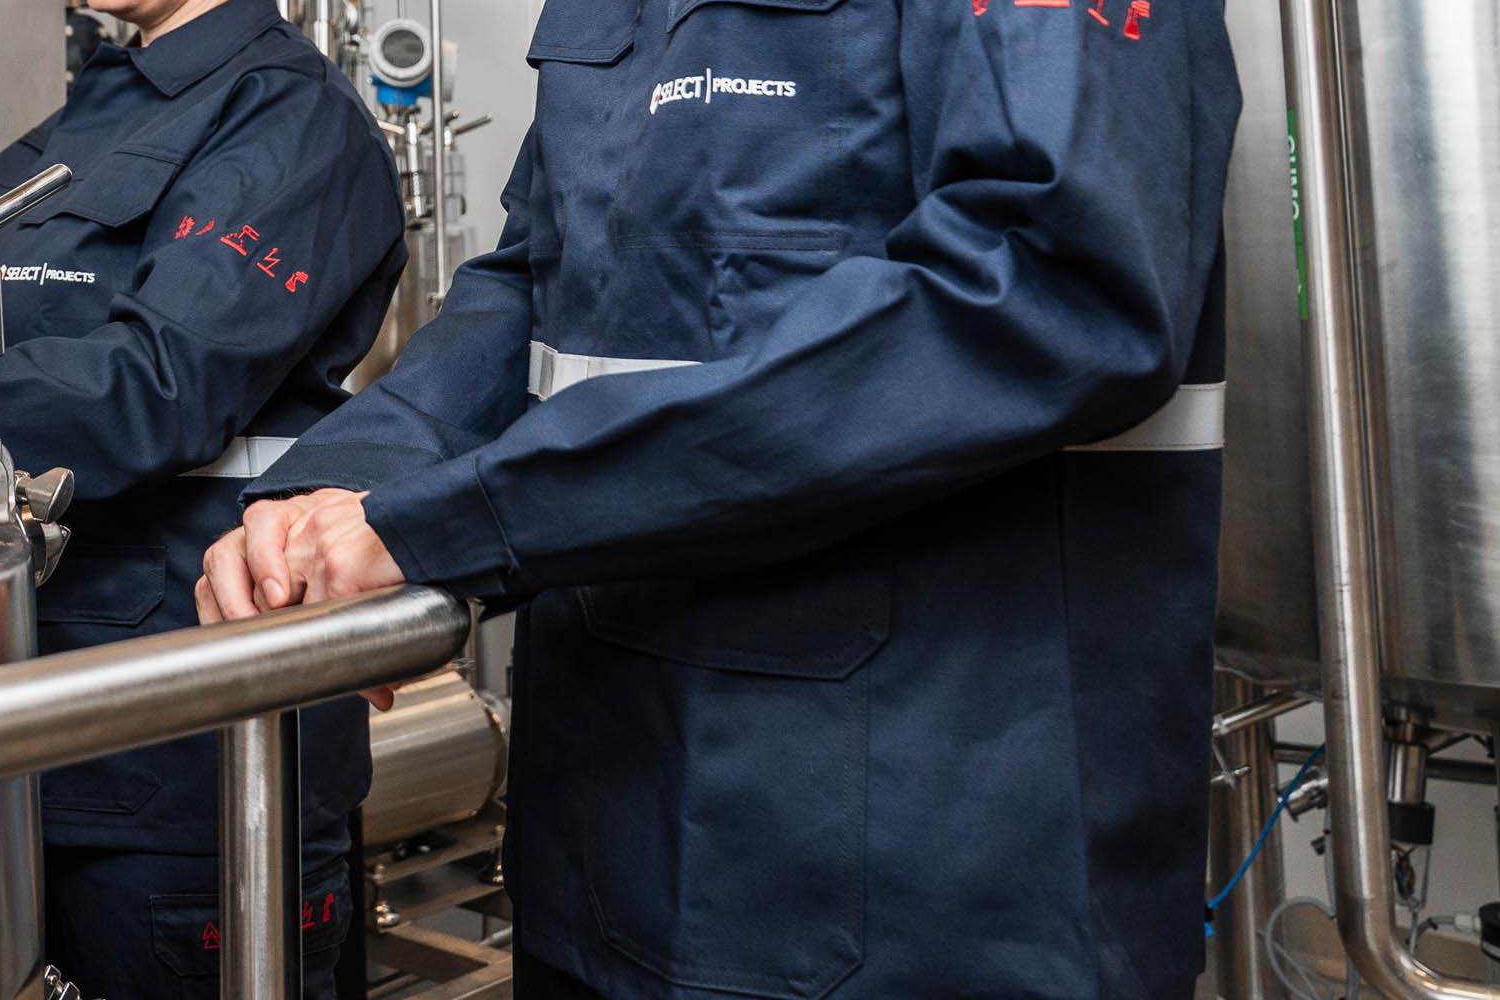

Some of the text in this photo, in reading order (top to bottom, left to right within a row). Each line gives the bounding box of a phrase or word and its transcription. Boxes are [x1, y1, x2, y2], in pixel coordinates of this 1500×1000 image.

[659, 76, 705, 105] SELECT
[712, 77, 797, 97] PROJECTS
[4, 266, 42, 281] SELECT
[45, 268, 96, 284] PROJECTS
